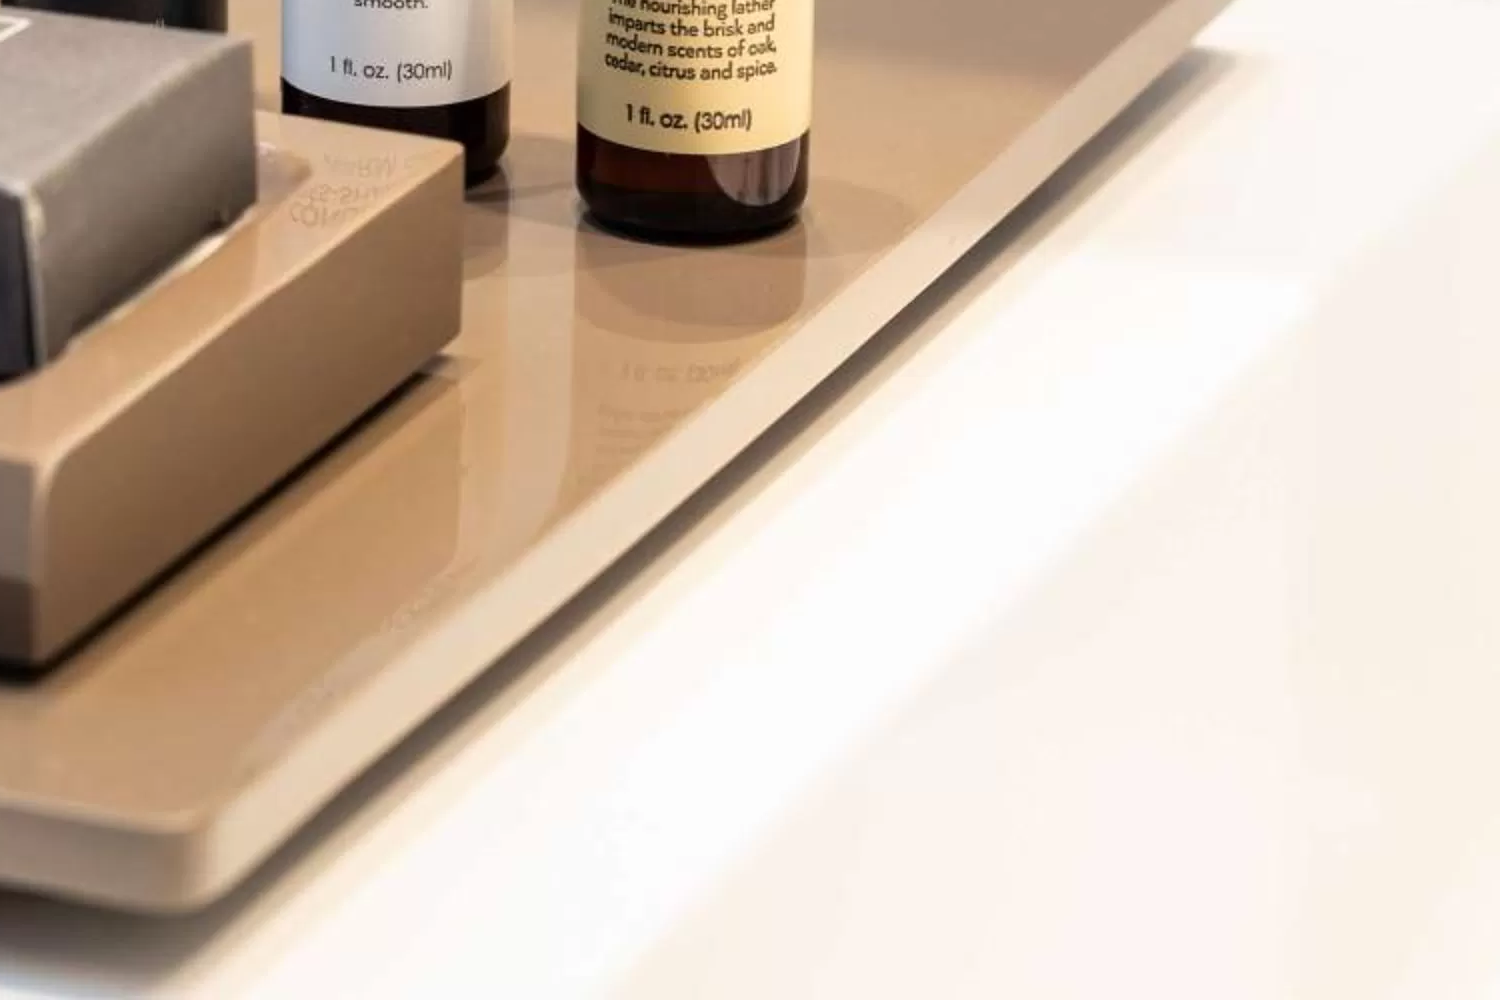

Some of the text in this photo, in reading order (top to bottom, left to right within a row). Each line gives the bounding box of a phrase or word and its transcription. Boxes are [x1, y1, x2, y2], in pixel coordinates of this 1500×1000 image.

[609, 8, 775, 37] imparts the brisk and
[606, 30, 663, 56] modern
[668, 44, 723, 59] scents
[728, 38, 745, 57] of
[343, 56, 357, 77] fl.
[363, 63, 389, 79] oz.
[397, 59, 452, 83] (30ml)
[605, 51, 646, 77] cedar,
[650, 61, 696, 80] citrus
[700, 61, 733, 81] and
[626, 104, 752, 133] 1 fl. oz. (30ml)
